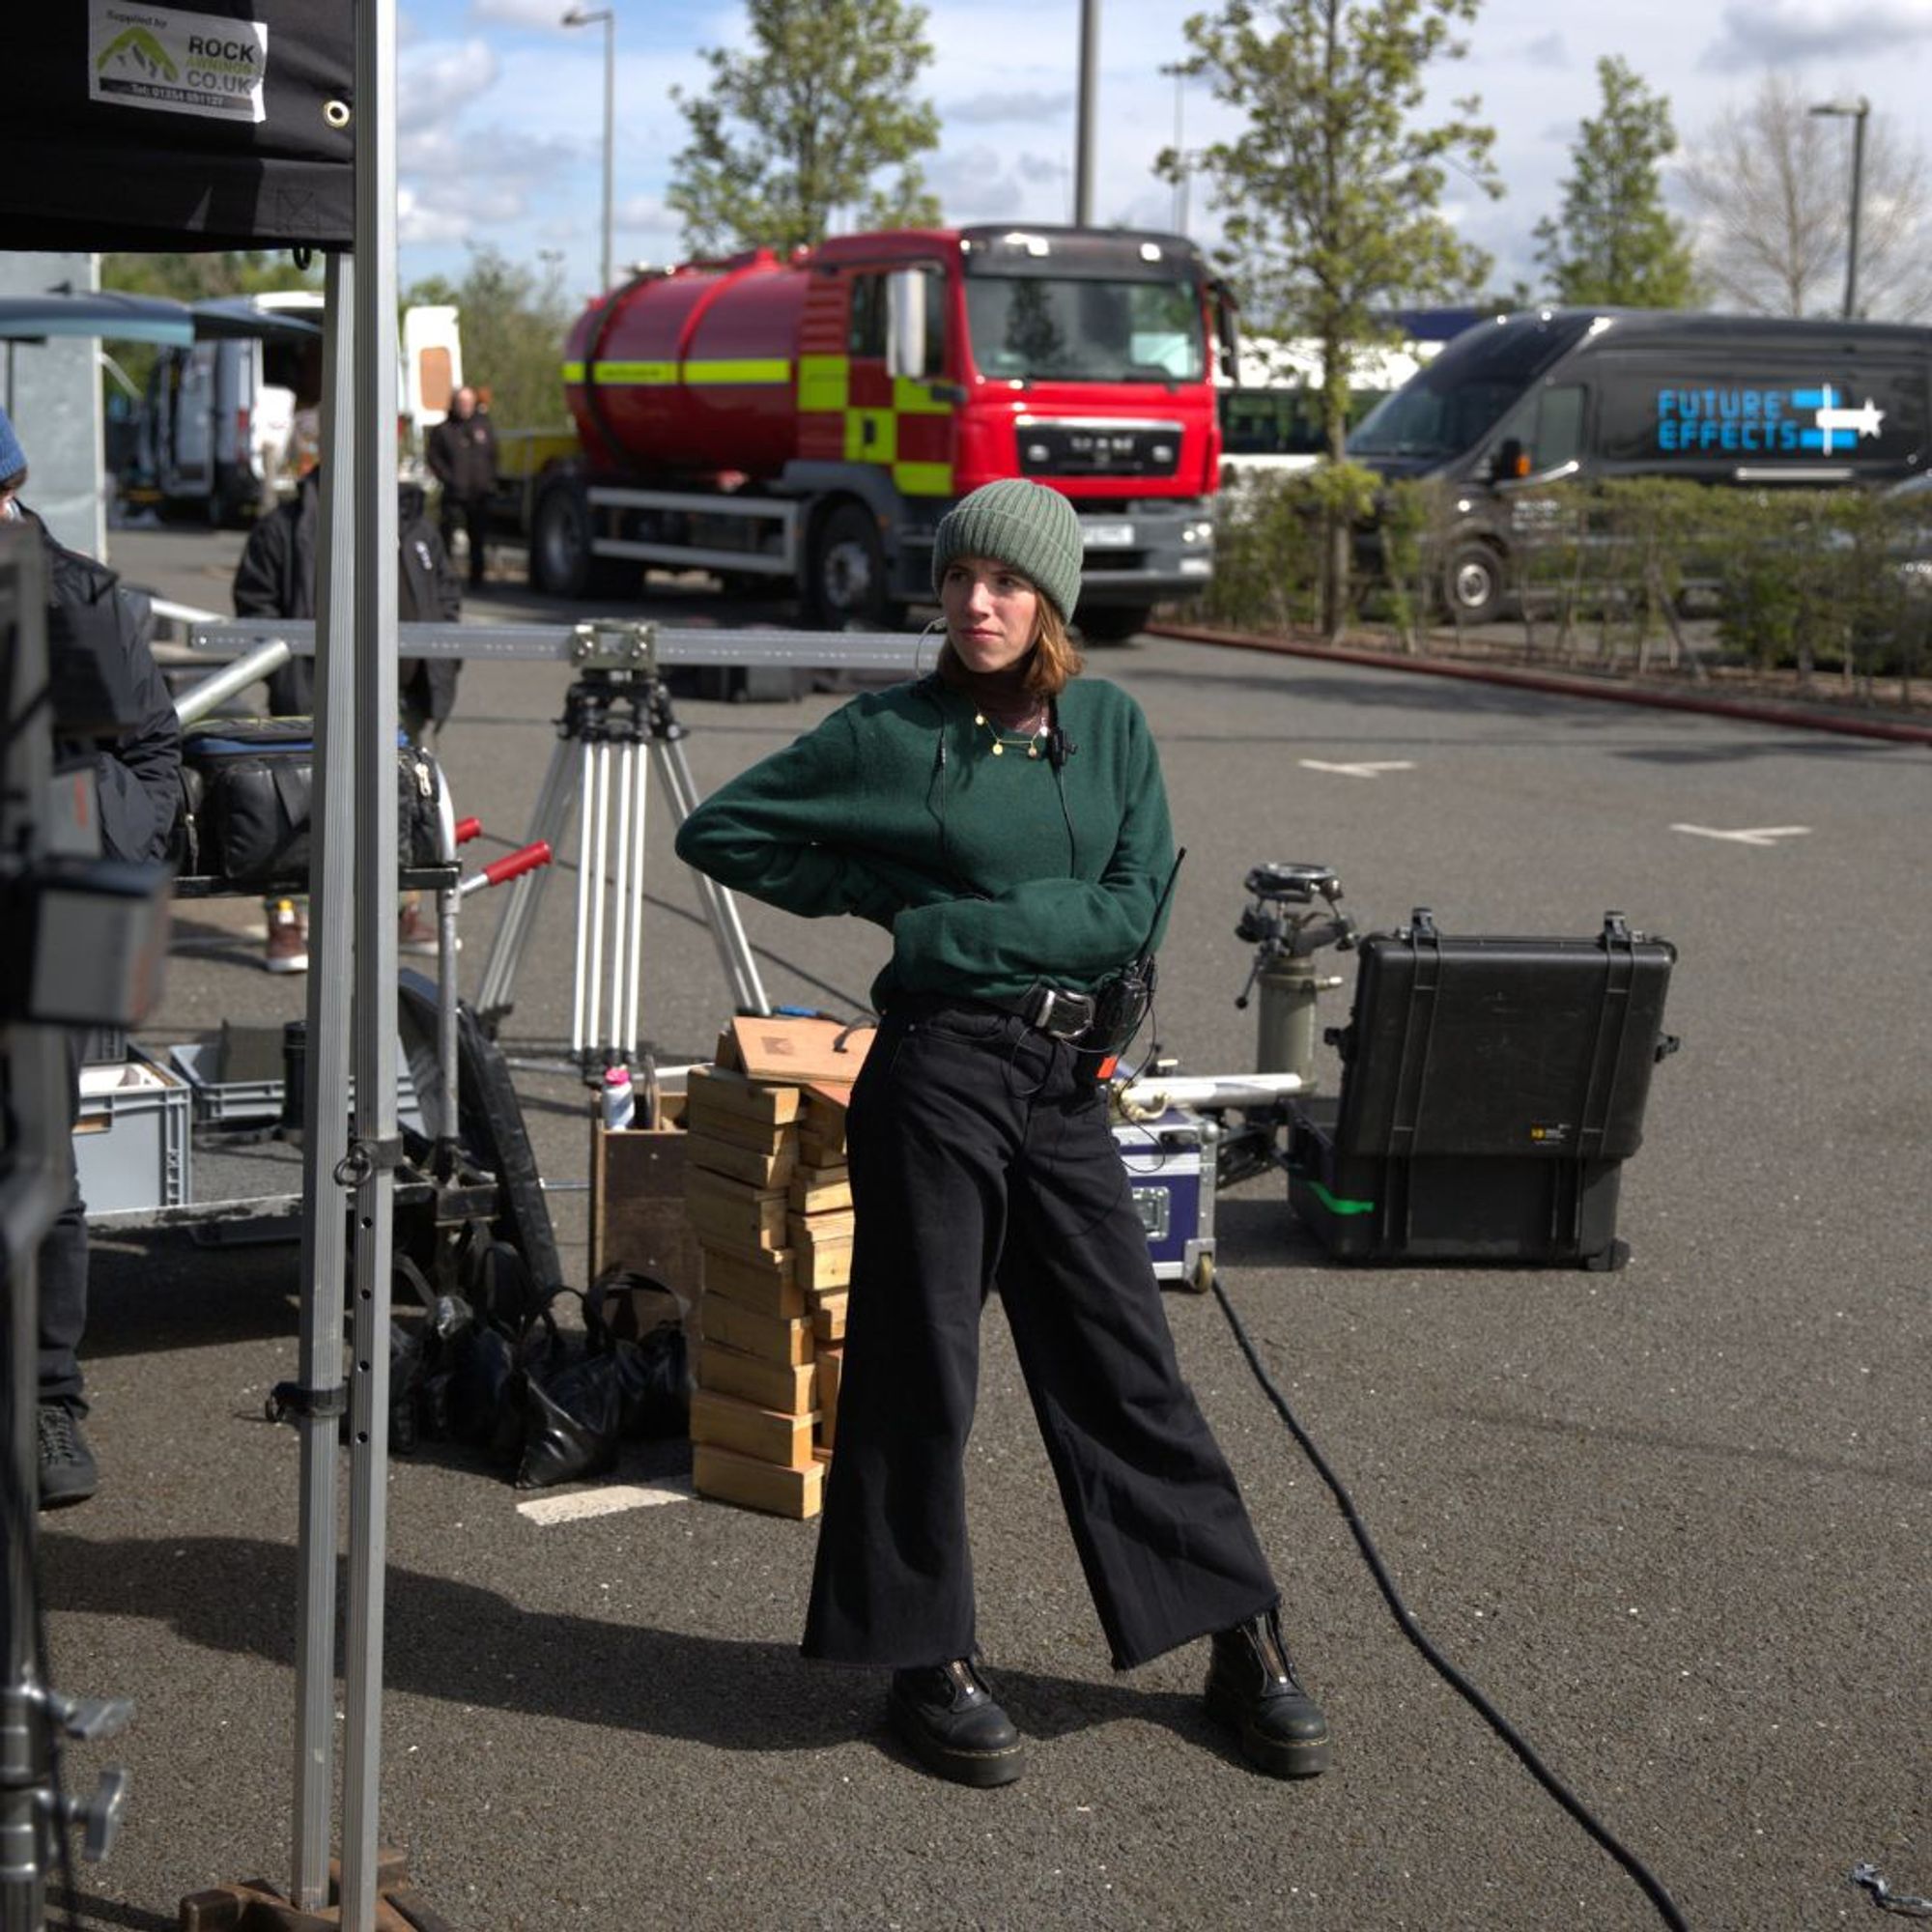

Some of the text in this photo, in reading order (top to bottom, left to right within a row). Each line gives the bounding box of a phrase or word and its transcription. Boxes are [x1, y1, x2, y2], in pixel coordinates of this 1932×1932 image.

[188, 36, 255, 63] ROCK
[187, 70, 253, 95] CO.UK
[1657, 388, 1783, 419] FUTURE
[1657, 419, 1798, 450] EFFECTS
